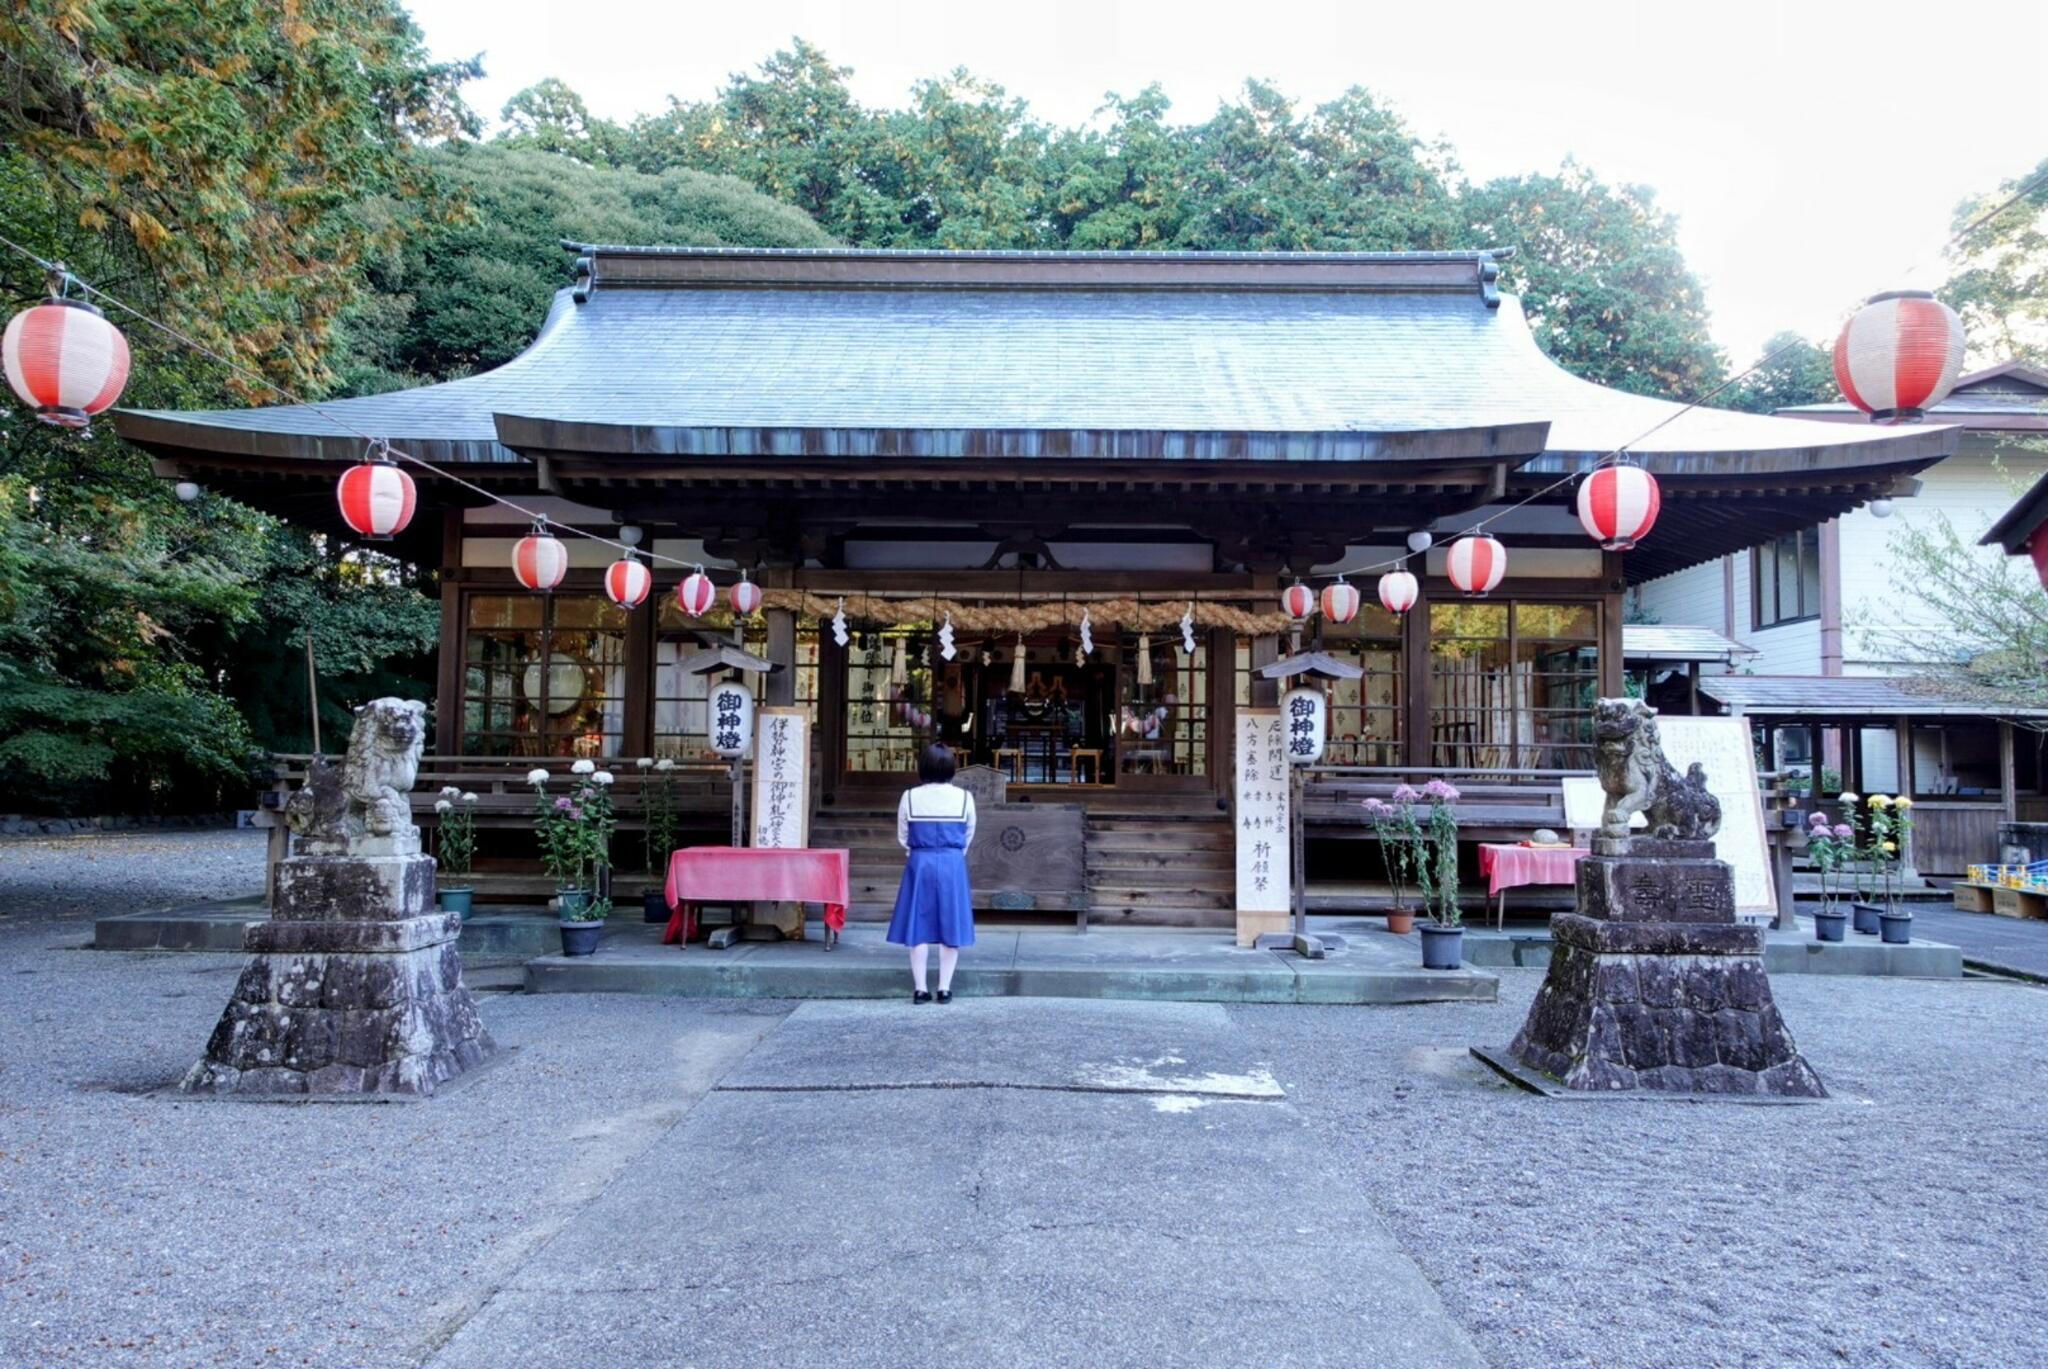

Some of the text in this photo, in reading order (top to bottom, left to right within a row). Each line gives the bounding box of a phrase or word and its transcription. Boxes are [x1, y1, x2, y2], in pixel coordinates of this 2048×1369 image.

[716, 690, 742, 750] 御神燈
[1289, 695, 1315, 756] 御神燈
